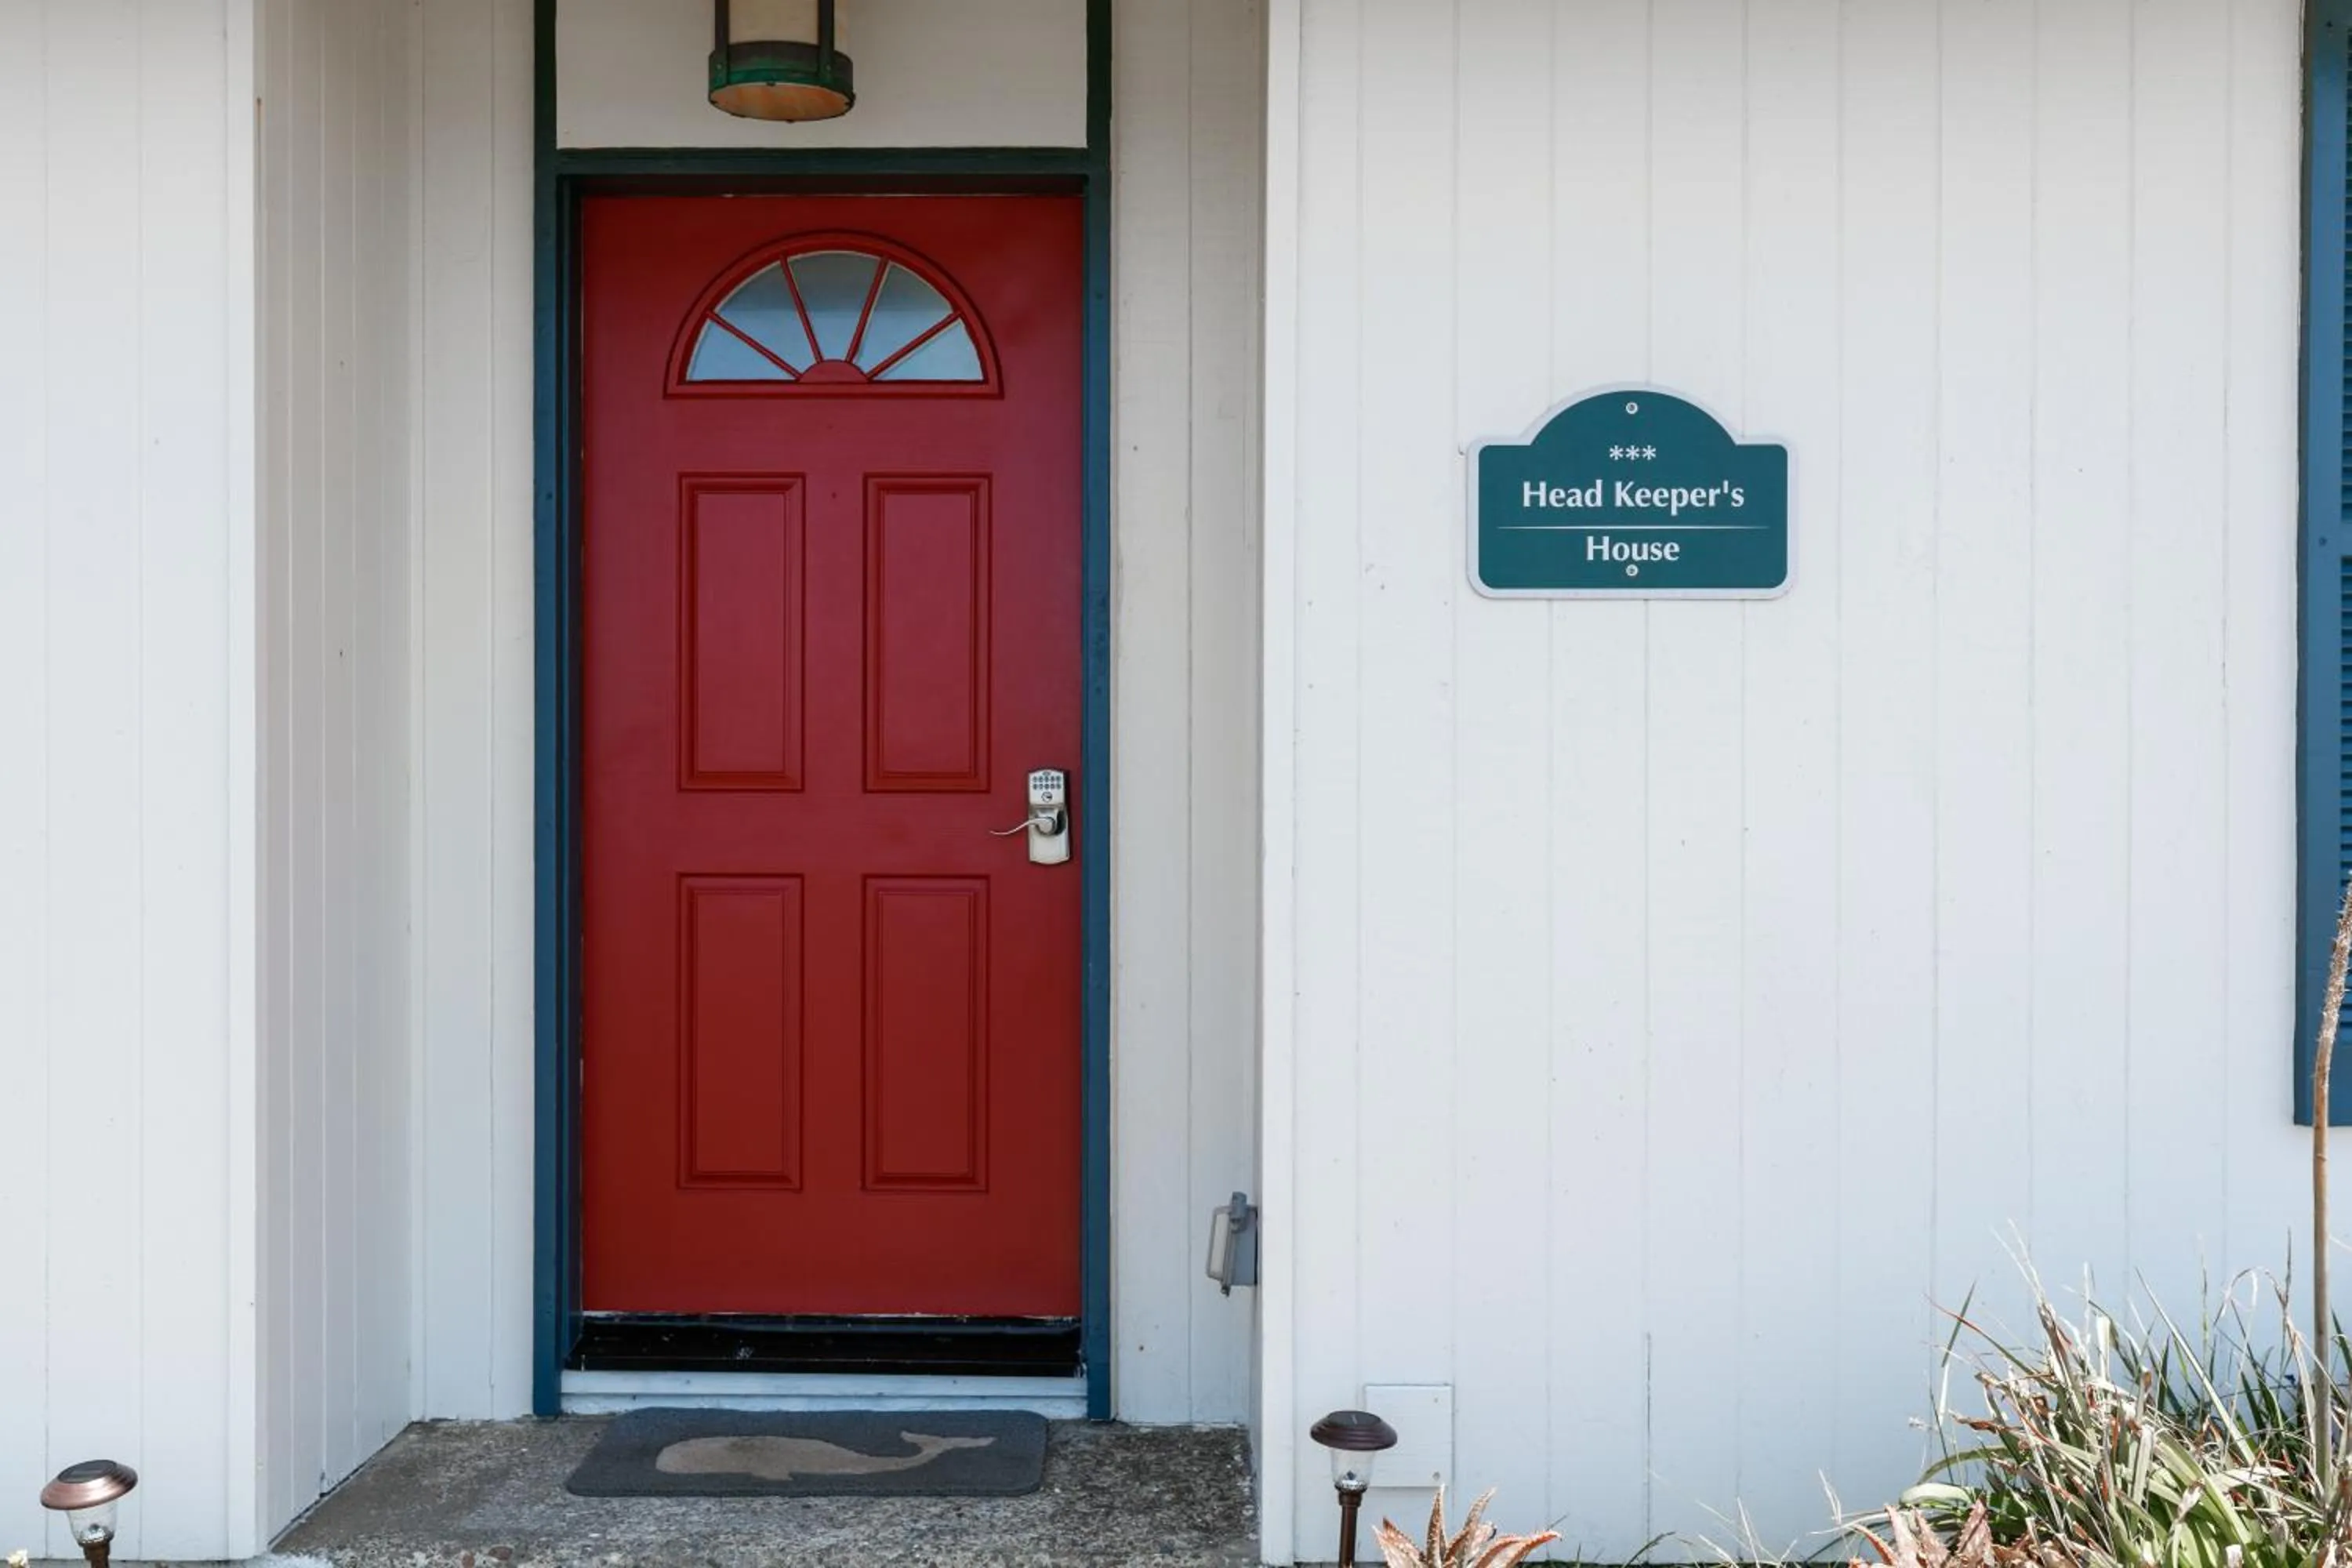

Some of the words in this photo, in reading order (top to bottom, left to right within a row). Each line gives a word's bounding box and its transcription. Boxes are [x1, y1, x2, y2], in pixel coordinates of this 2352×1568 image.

[1523, 479, 1602, 507] Head
[1615, 480, 1744, 516] Keeper's
[1586, 535, 1679, 561] House
